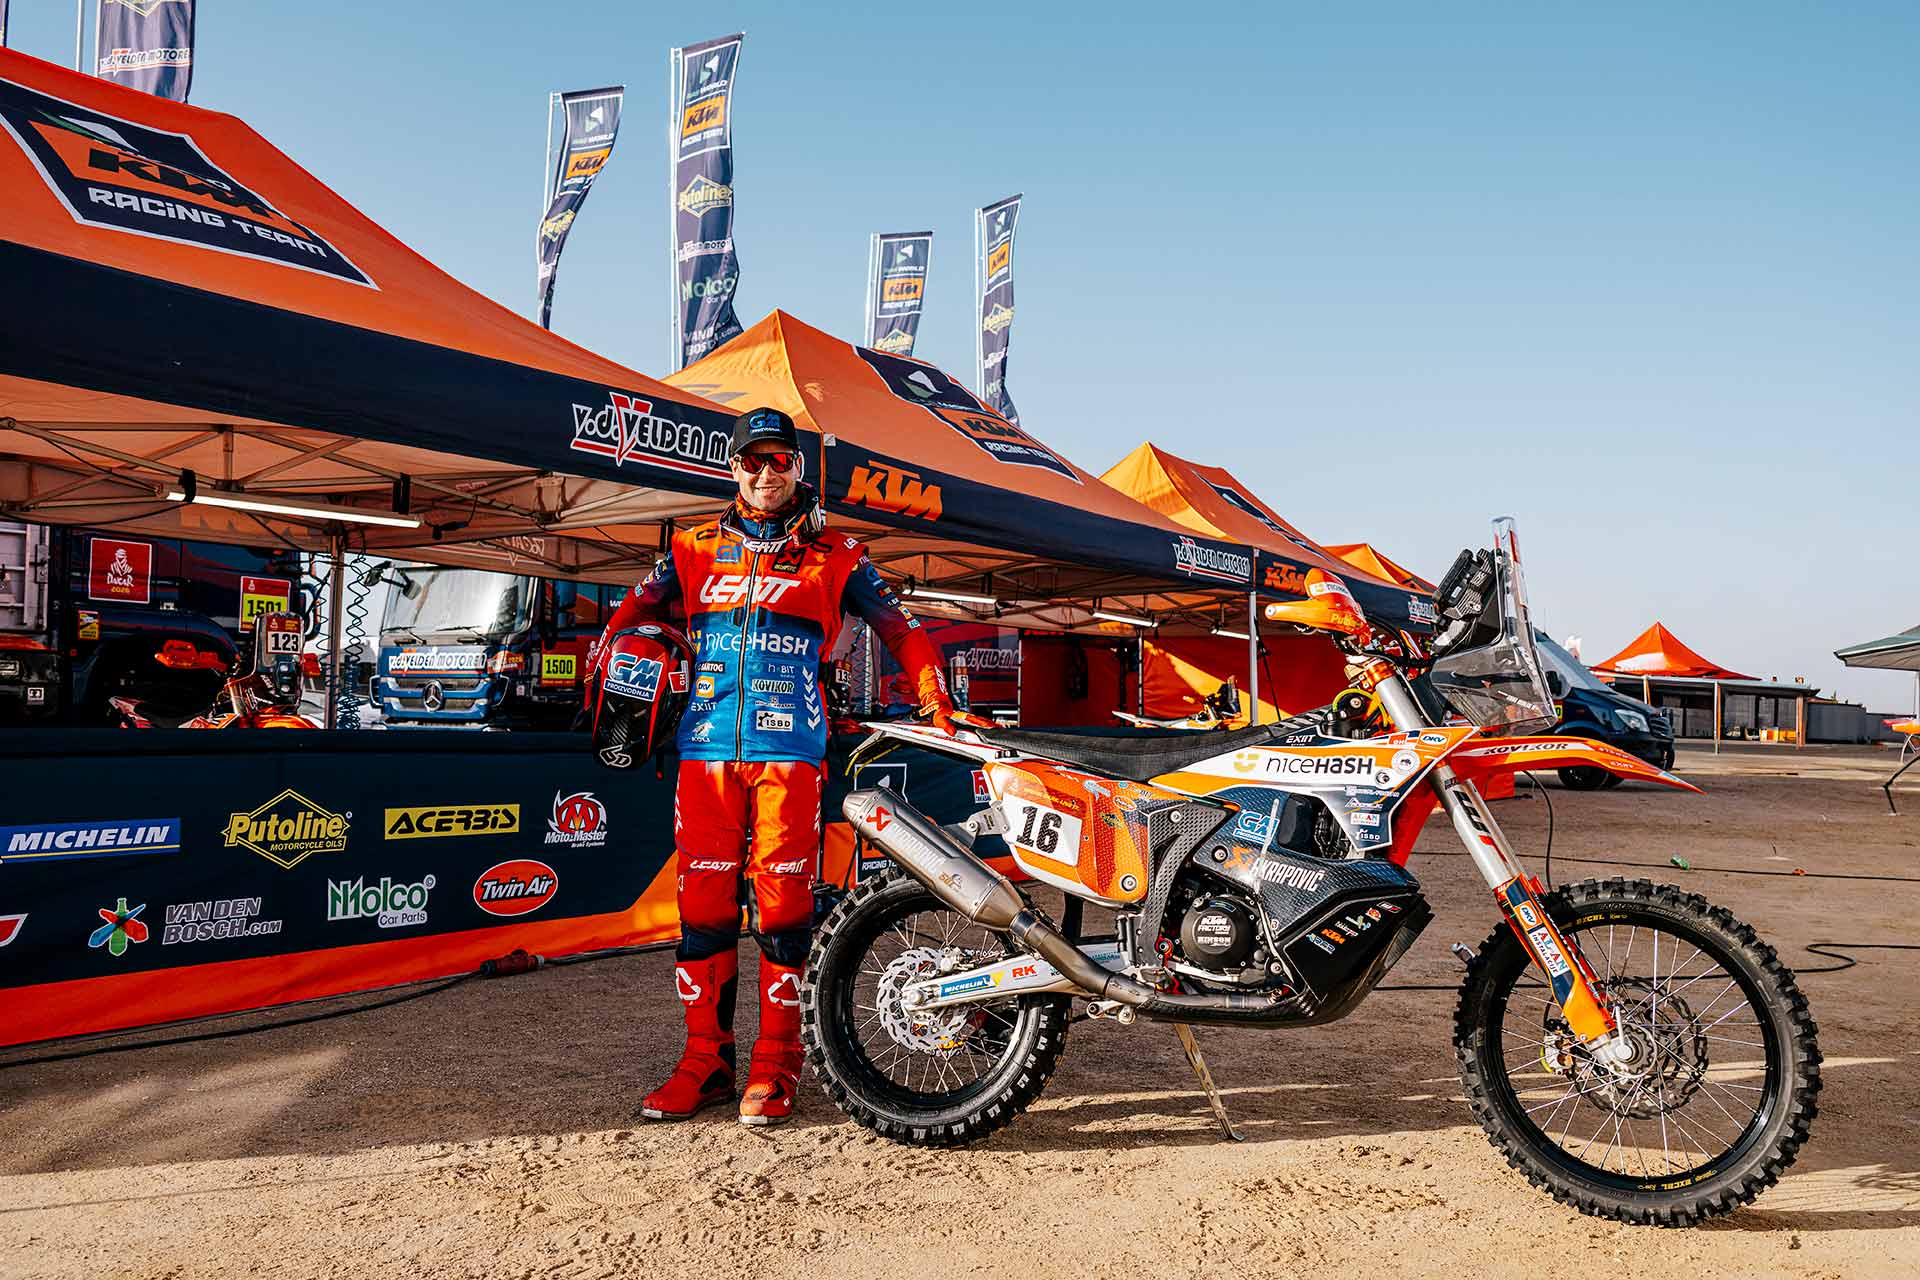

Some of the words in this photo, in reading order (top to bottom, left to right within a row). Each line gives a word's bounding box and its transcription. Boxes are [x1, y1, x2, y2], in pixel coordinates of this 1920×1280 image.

[686, 104, 720, 129] KTM
[572, 154, 605, 172] KTM
[88, 148, 273, 219] KTM
[962, 417, 1029, 441] KTM
[841, 460, 943, 521] KTM
[107, 572, 134, 588] DAKAR
[1264, 561, 1306, 596] KTM
[699, 575, 801, 604] LEATT
[271, 633, 299, 652] 123
[546, 659, 574, 675] 1500
[607, 681, 650, 698] PROIZVODNJA
[752, 680, 794, 693] KOVIKOR
[1286, 735, 1316, 744] EXIIT
[1422, 735, 1446, 743] DKV
[1483, 742, 1569, 755] KOVIKOR
[228, 812, 343, 844] Putoline
[1017, 805, 1063, 854] 16
[8, 826, 170, 852] MICHELIN
[270, 842, 323, 851] MOTORCYCLE
[325, 840, 343, 849] OILS
[862, 861, 886, 870] RACING
[482, 877, 525, 900] Twin
[525, 875, 554, 896] Air
[165, 902, 212, 924] VAN
[214, 897, 262, 919] DEN
[380, 914, 399, 926] Car
[401, 911, 426, 923] Parts
[1012, 964, 1037, 978] RK
[944, 980, 983, 993] MICHELIN
